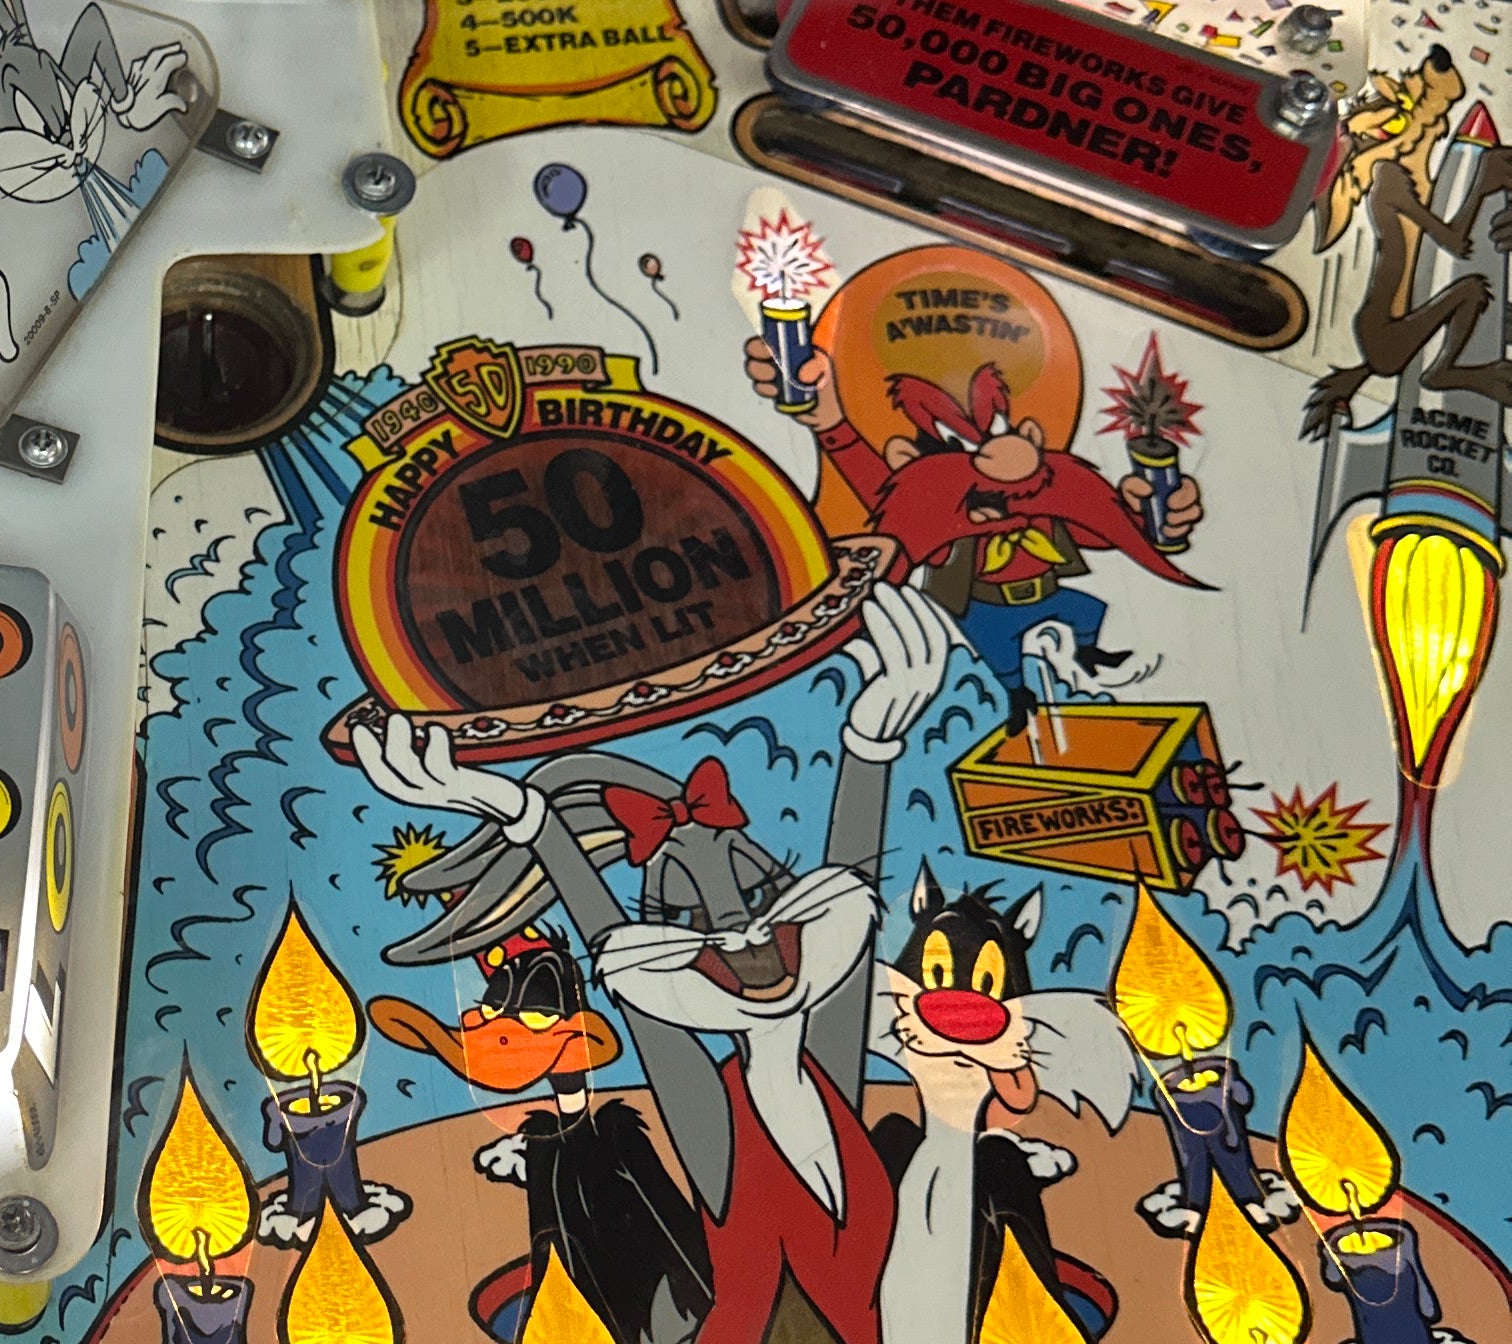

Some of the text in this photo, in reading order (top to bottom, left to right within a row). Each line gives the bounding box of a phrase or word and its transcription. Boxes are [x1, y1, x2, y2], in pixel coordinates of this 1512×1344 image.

[601, 23, 676, 47] BALL
[846, 3, 1007, 76] 50,000
[1012, 58, 1105, 116] BIG
[1110, 91, 1266, 175] ONES,
[982, 16, 1168, 98] FIREWORKS
[1171, 80, 1250, 126] GIVE
[903, 59, 1180, 180] PARDNER!
[895, 287, 1011, 314] TIME'S
[448, 363, 508, 418] 50
[524, 354, 597, 376] 1990
[371, 391, 439, 444] 1940
[1410, 407, 1491, 440] ACME
[368, 399, 733, 532] HAPPY BIRTHDAY
[1400, 429, 1496, 464] ROCKET
[1426, 455, 1460, 478] CO.
[457, 447, 645, 581] 50
[434, 527, 752, 665] MILLION
[514, 600, 717, 684] WHEN LIT
